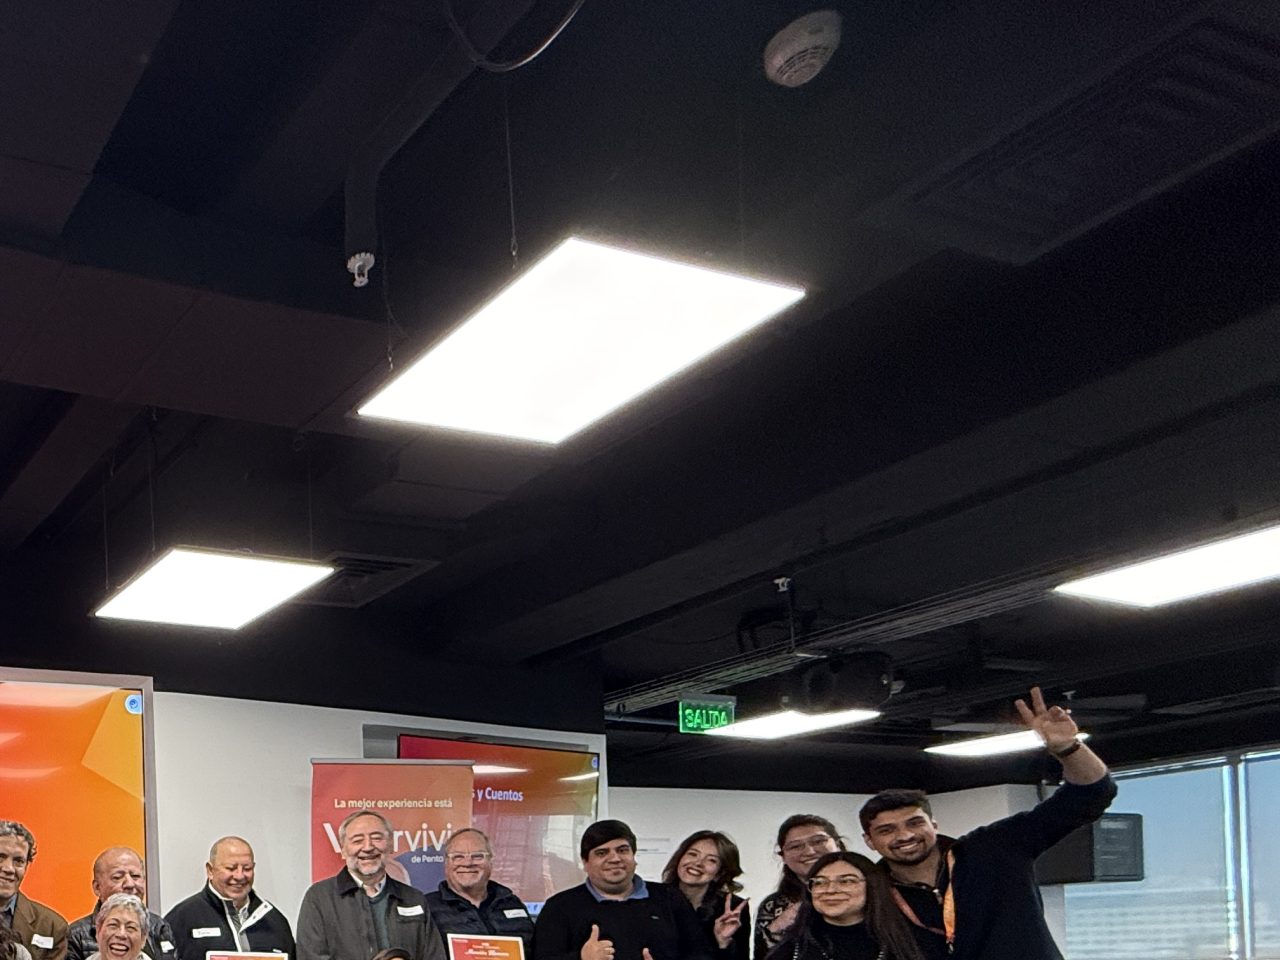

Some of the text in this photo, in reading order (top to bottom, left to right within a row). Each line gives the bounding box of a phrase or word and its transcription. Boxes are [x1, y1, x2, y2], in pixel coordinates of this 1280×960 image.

[685, 708, 728, 728] SALIDA
[477, 789, 483, 802] y
[485, 787, 524, 801] Cuentos
[334, 798, 453, 810] La mejor experiencia está
[411, 855, 444, 863] de Penta
